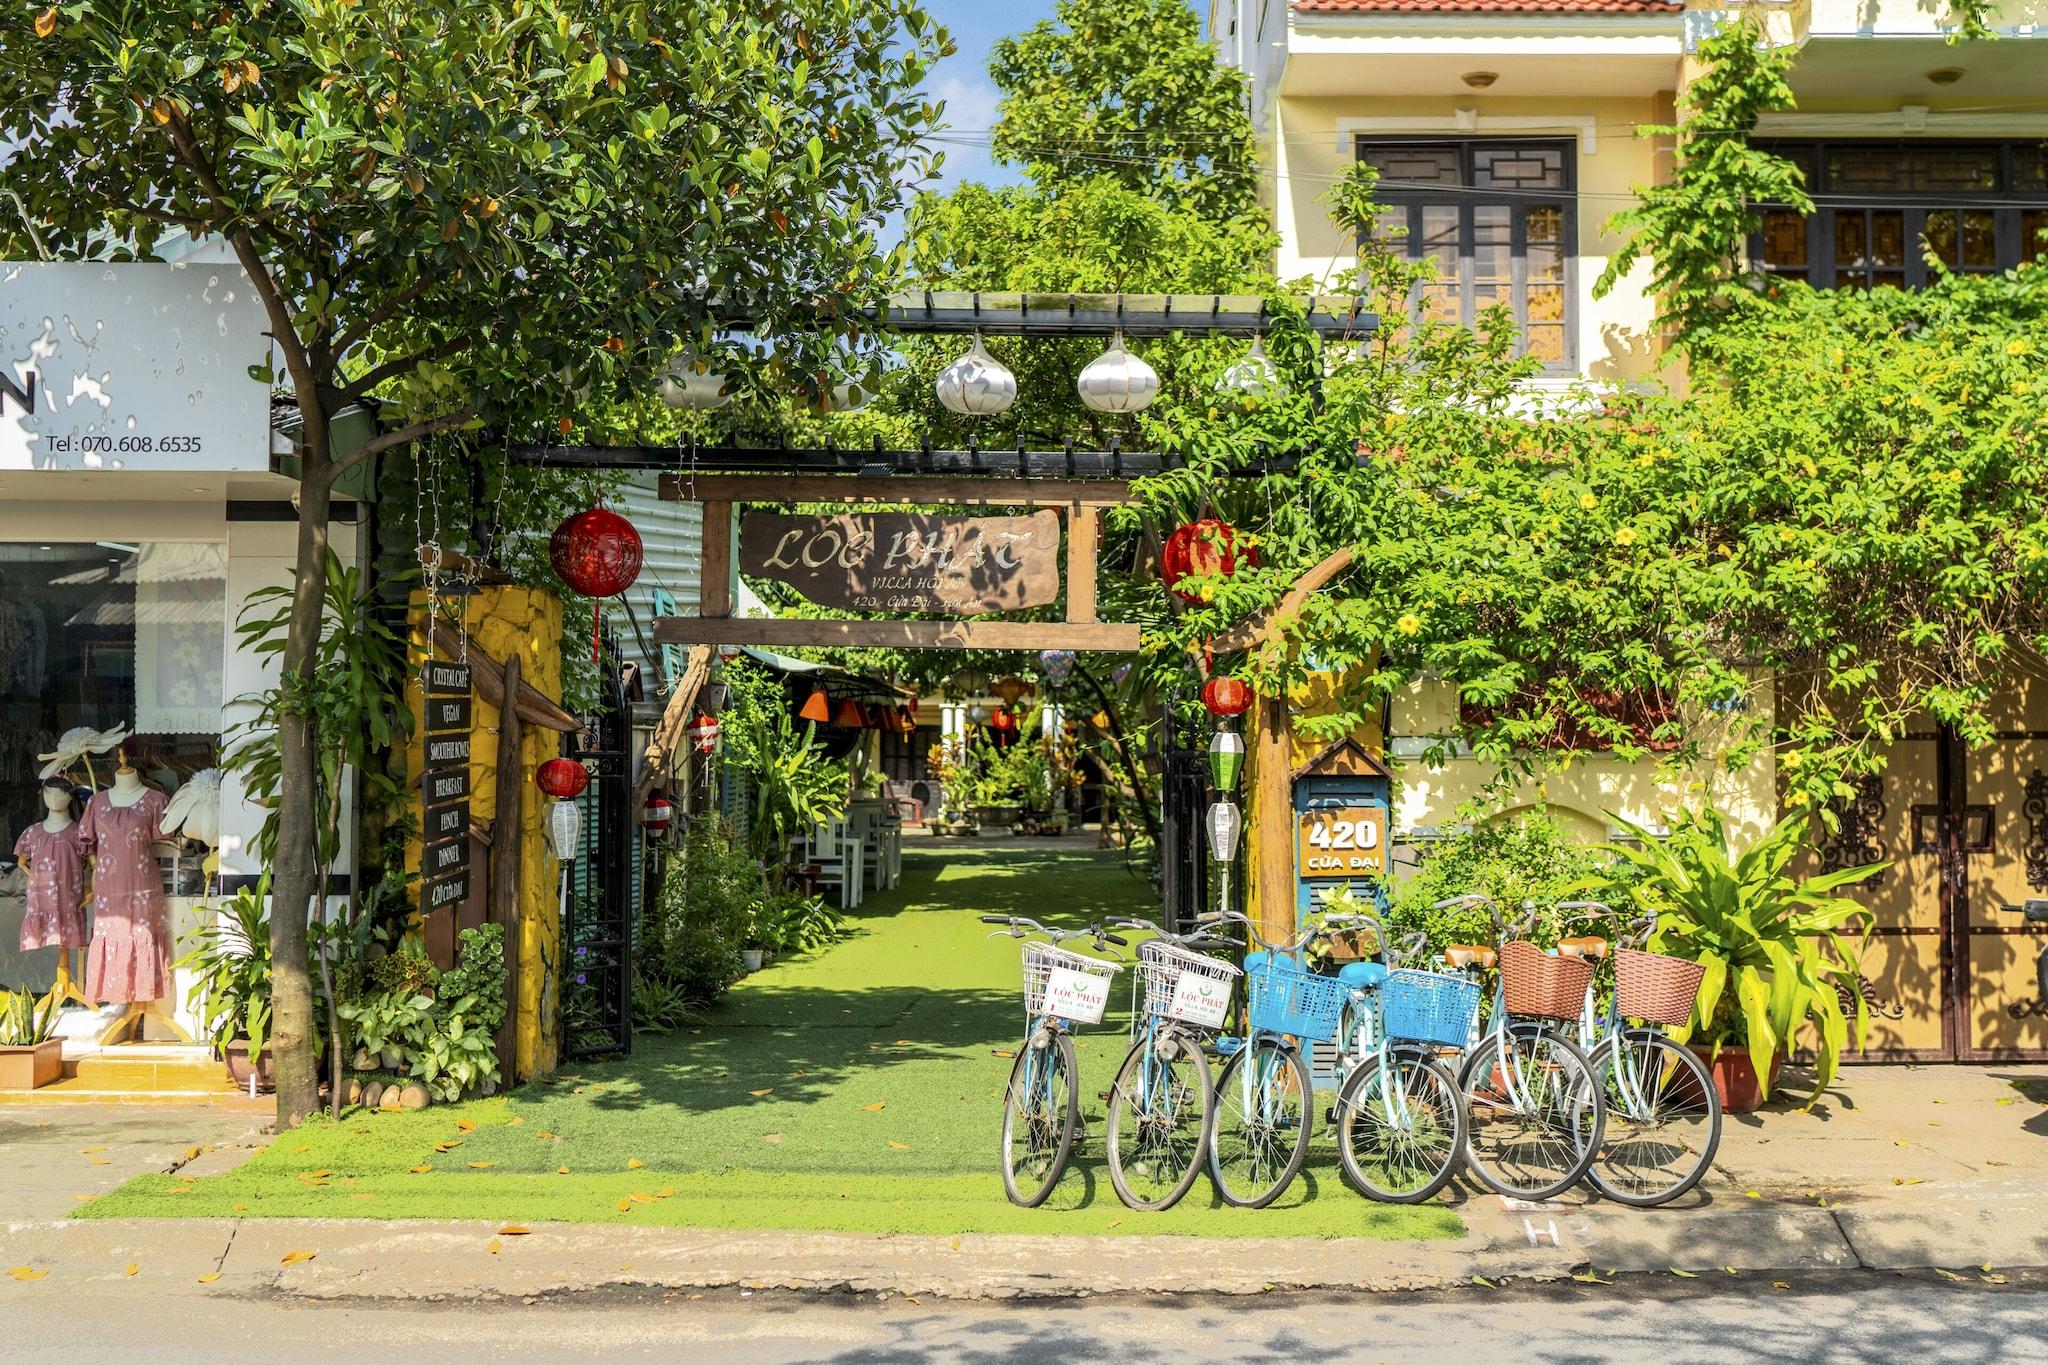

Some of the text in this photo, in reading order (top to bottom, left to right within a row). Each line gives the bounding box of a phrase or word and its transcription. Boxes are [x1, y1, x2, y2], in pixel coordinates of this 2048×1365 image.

[882, 521, 1033, 570] PHÁT
[872, 576, 912, 590] VILLA
[852, 596, 877, 607] 420
[433, 667, 455, 686] CRYSTAL
[443, 704, 460, 723] VEGAN
[435, 777, 463, 797] BREAKFAST
[441, 810, 459, 831] LUNCH
[1309, 821, 1378, 849] 420
[438, 844, 460, 868] DINNER
[431, 884, 443, 906] 420
[1175, 1007, 1183, 1016] 2
